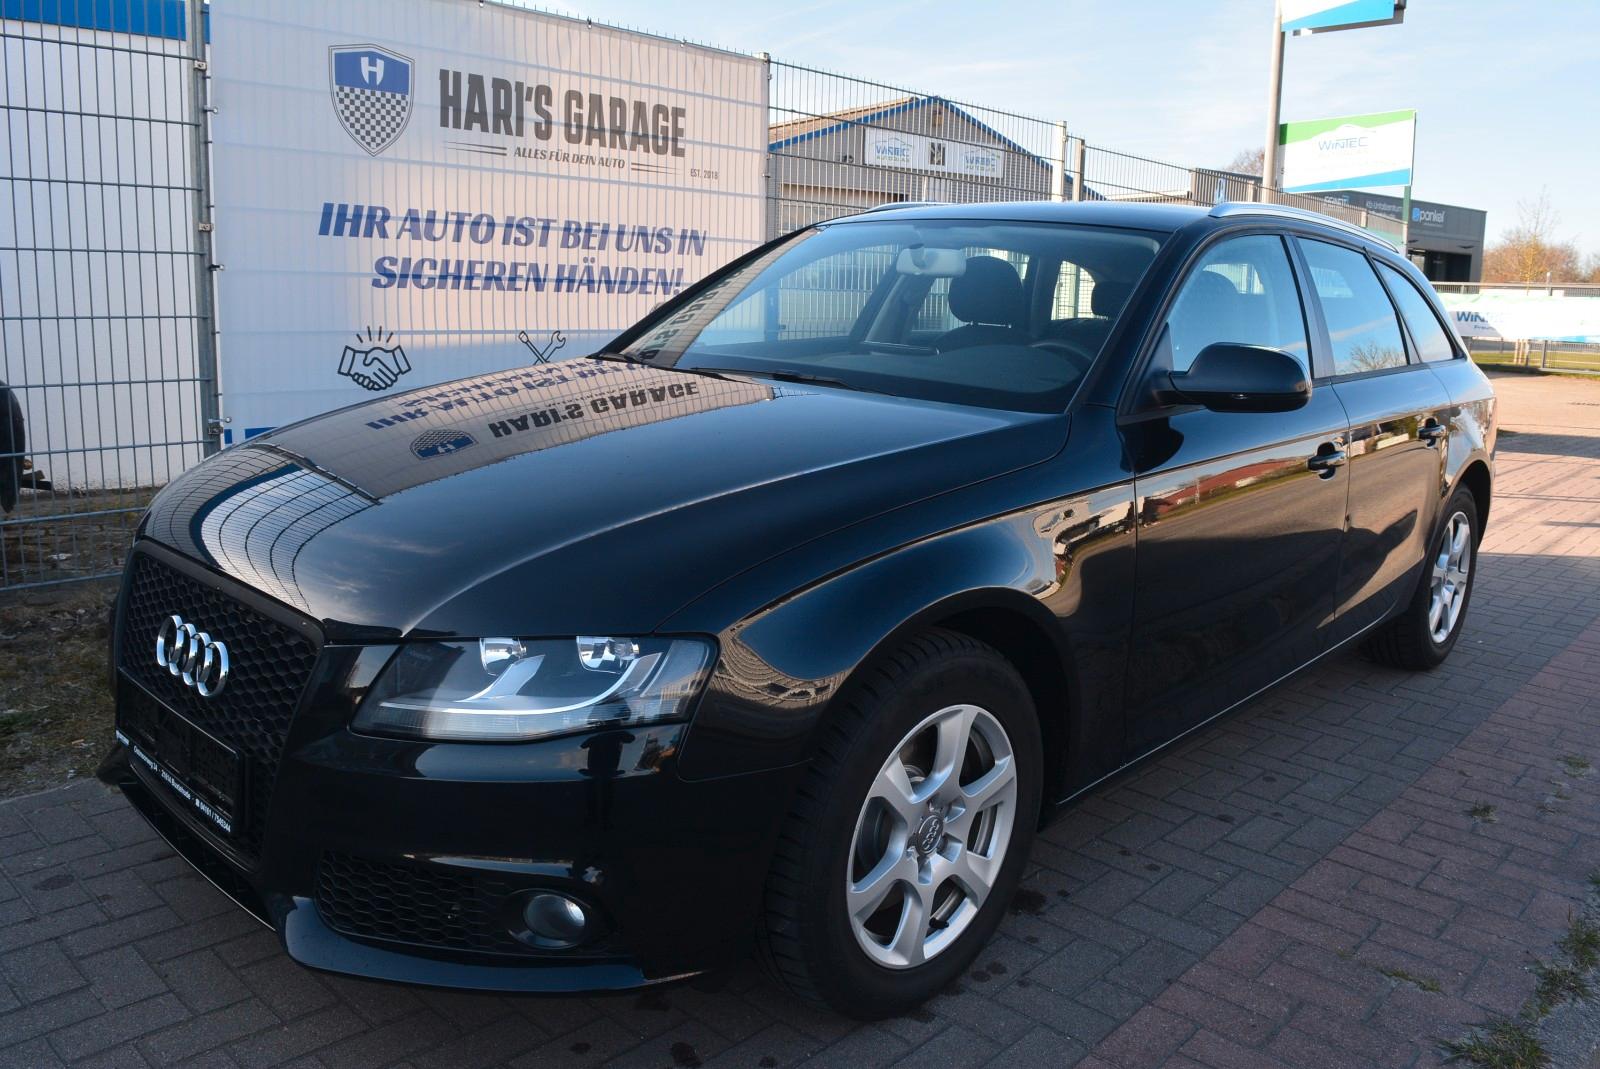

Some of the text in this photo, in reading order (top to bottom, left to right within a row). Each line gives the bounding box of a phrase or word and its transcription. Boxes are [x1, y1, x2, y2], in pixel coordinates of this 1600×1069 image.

[361, 56, 384, 86] H
[439, 68, 686, 158] HARI'S GARAGE
[514, 146, 625, 169] ALLES FÜR DEIN AUTO
[690, 168, 719, 180] EST. 2018
[318, 202, 707, 256] IHR AUTO IST BEI UNS IN
[371, 255, 684, 296] SICHEREN HÄNDEN!
